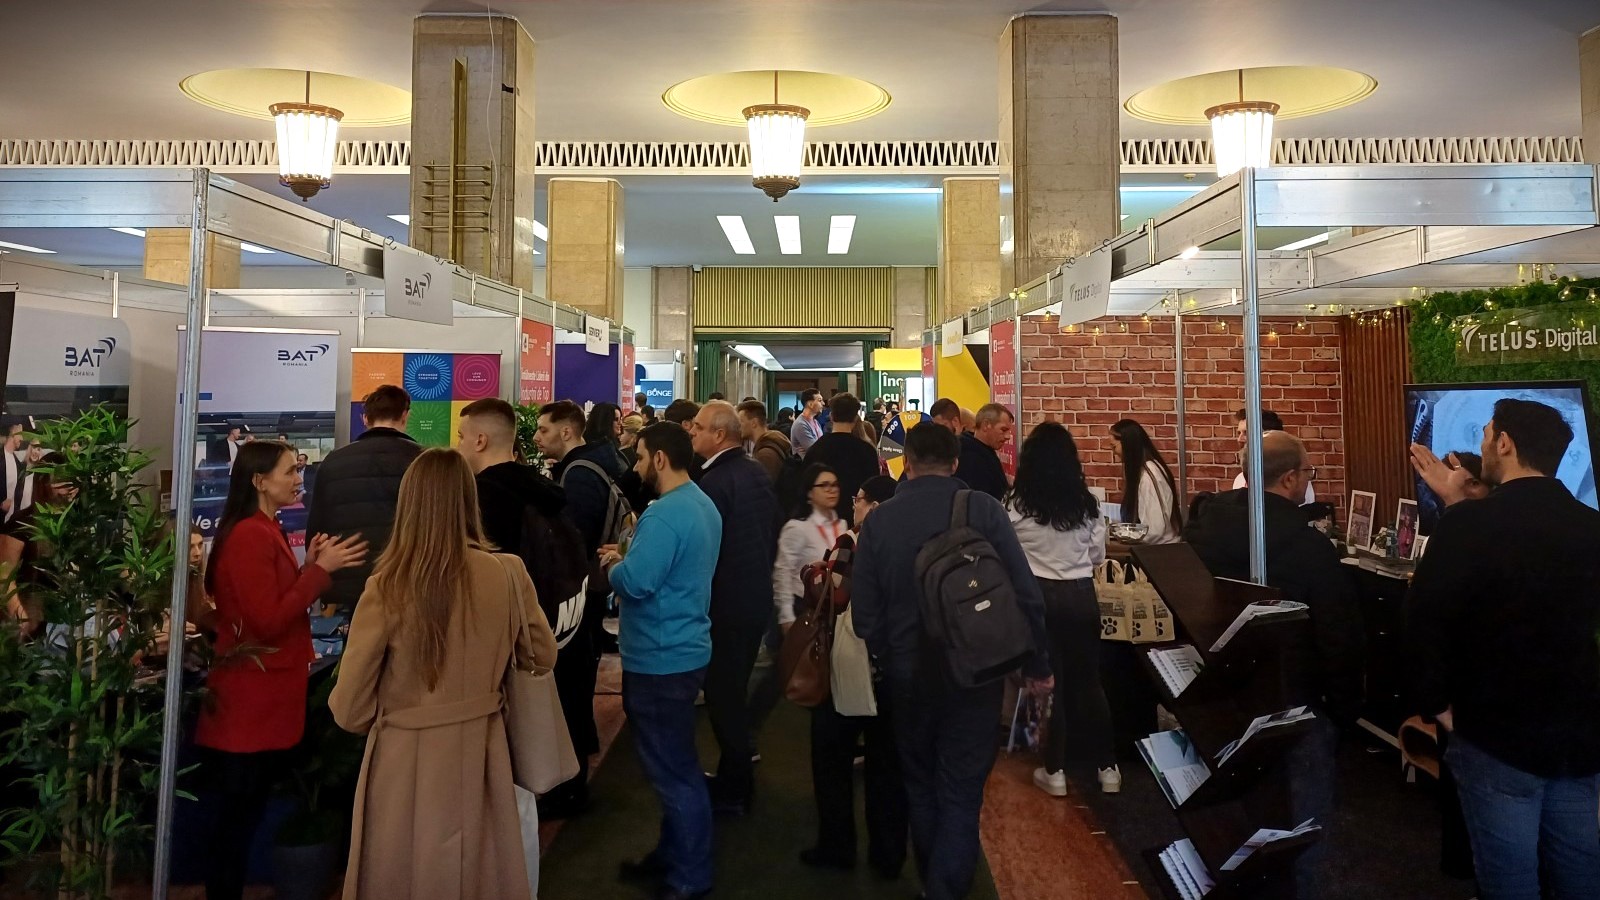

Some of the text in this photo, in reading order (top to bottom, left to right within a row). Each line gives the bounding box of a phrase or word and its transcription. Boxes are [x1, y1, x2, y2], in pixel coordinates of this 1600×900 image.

[405, 277, 427, 299] BAT
[1074, 285, 1090, 302] TELUS
[1478, 324, 1598, 352] TELUS Digital
[65, 346, 105, 367] BAT
[277, 350, 319, 361] BAT
[904, 413, 916, 421] 100
[887, 420, 899, 435] 500
